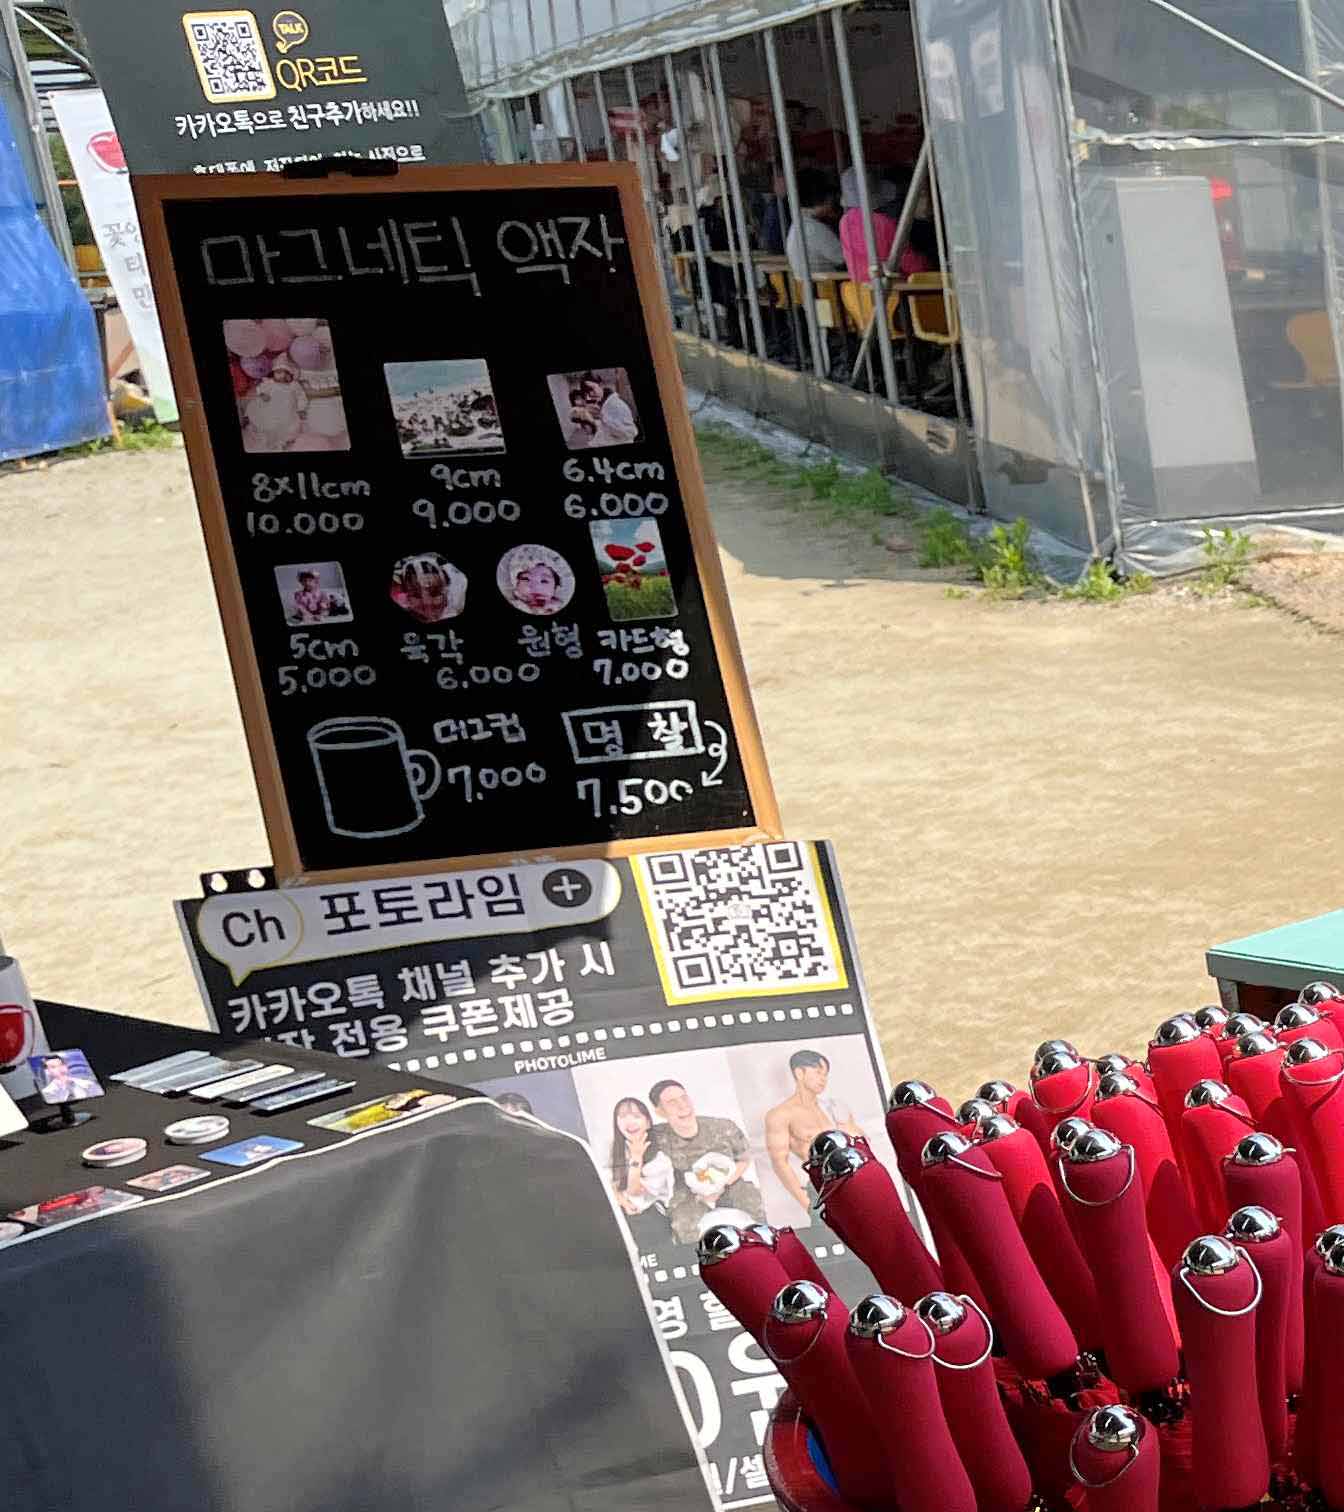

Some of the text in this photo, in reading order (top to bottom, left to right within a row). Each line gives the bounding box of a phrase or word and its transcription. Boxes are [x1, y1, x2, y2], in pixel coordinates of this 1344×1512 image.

[276, 56, 368, 92] QR코드
[174, 99, 420, 140] 카카오톡으로 친구추가하세요!!
[202, 214, 624, 297] 마그네틱 액자
[429, 463, 502, 490] 9cm
[563, 457, 665, 484] 6.4cm
[289, 632, 359, 661] 5cm
[399, 630, 464, 665] 육각
[517, 621, 583, 659] 원형
[596, 625, 691, 656] 카드형
[433, 711, 526, 745] 머그컵
[221, 873, 526, 947] Ch 포토라임
[228, 941, 616, 1034] 카카오톡 채널 추가 시
[327, 1013, 409, 1060] 전용
[419, 987, 575, 1043] 쿠폰제공
[514, 1046, 607, 1074] PHOTOLIME
